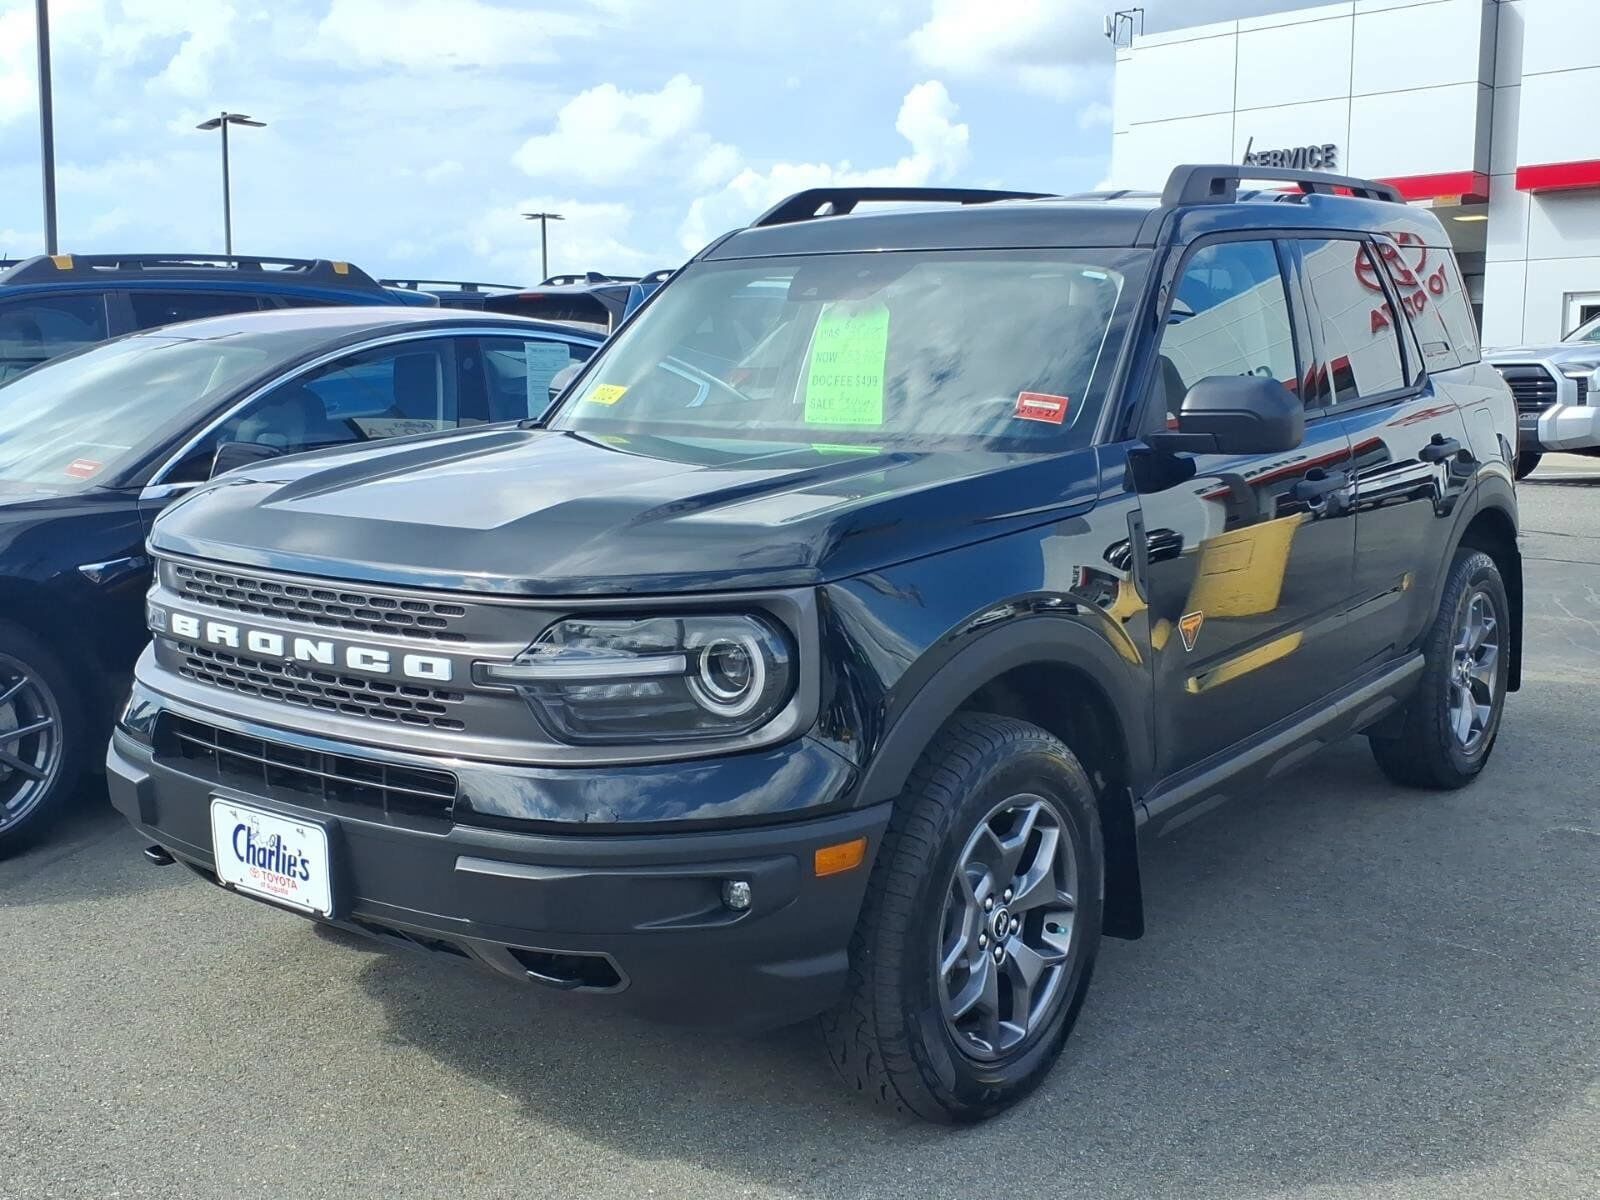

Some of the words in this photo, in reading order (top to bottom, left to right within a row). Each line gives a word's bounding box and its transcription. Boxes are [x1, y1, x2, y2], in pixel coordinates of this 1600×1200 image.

[815, 351, 838, 363] NOW
[171, 612, 452, 682] BRONCO
[232, 823, 310, 882] Charlie's
[262, 870, 298, 890] TOYOTA
